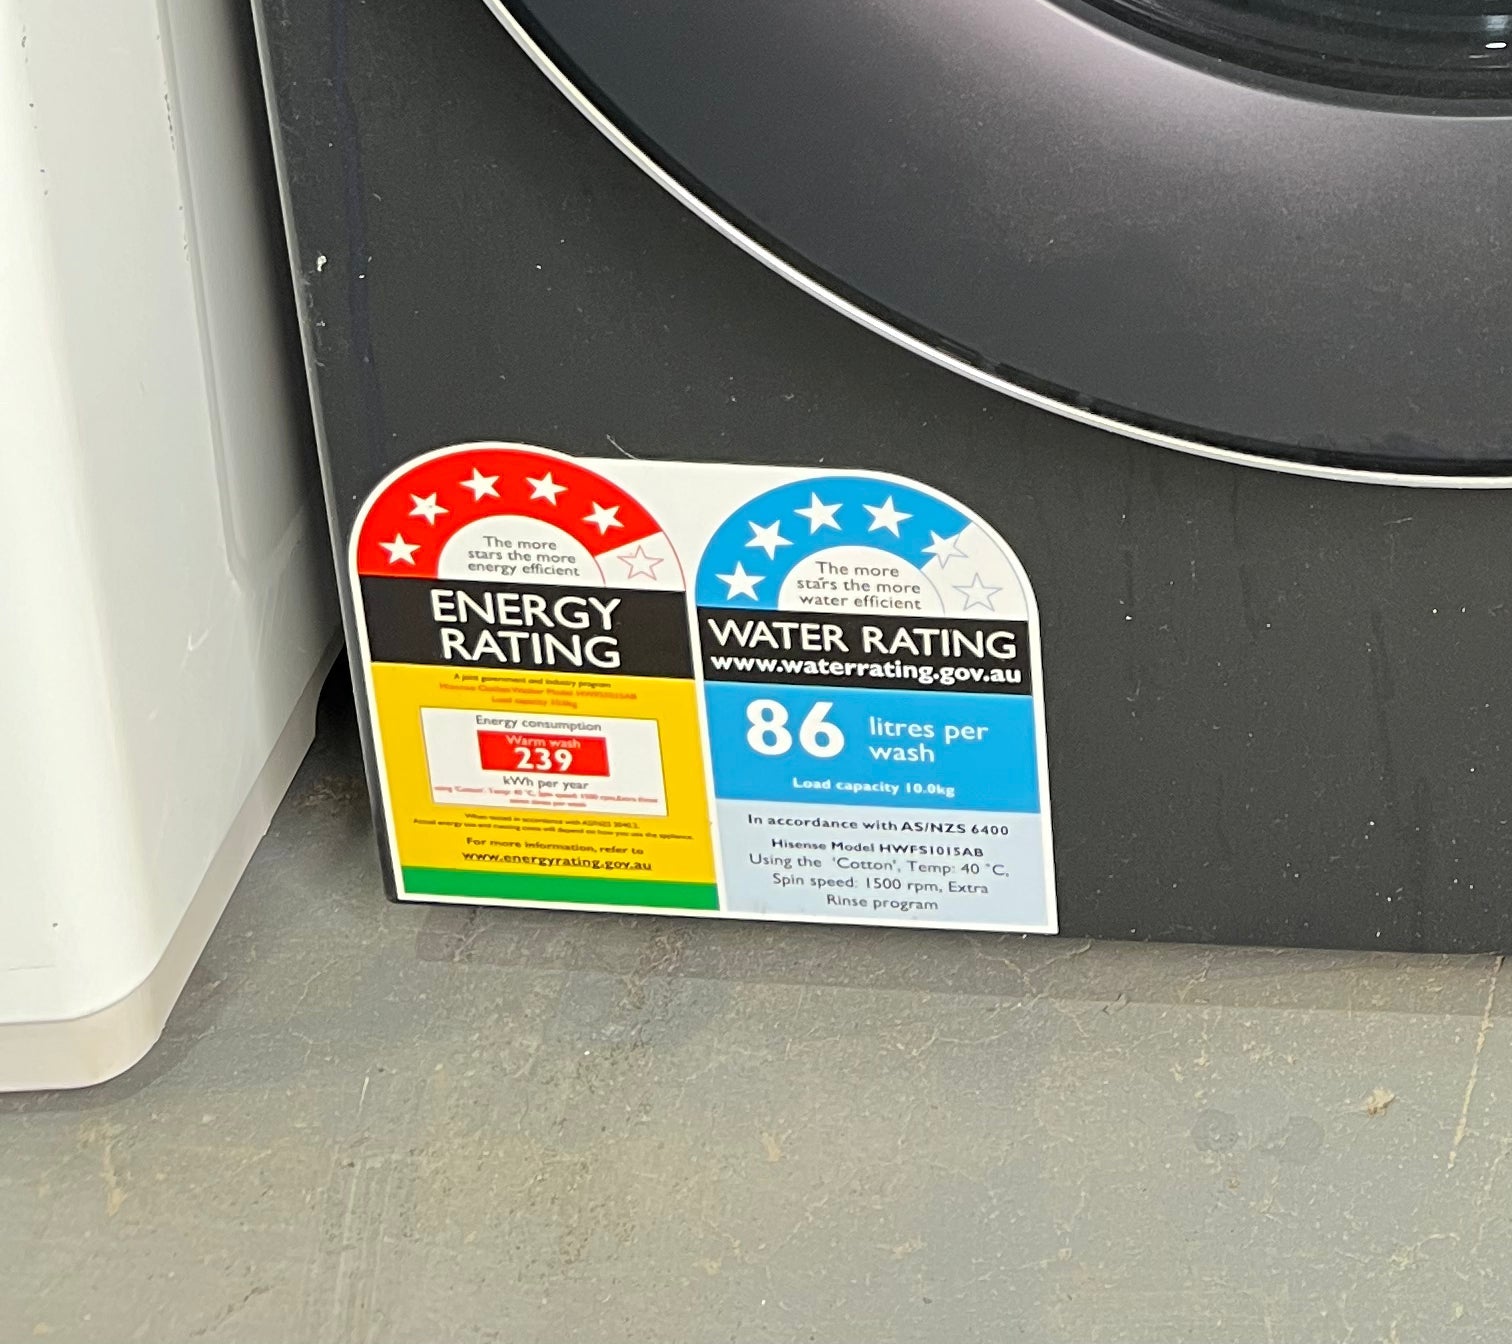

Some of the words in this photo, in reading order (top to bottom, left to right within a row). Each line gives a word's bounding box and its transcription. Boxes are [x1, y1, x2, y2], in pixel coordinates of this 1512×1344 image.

[483, 535, 513, 549] The
[517, 540, 557, 551] more
[468, 549, 504, 561] stars
[507, 550, 533, 562] the
[537, 553, 576, 564] more
[468, 563, 518, 576] energy
[522, 563, 580, 577] efficient
[815, 561, 849, 576] The
[854, 565, 900, 578] more
[797, 577, 838, 590] stars
[843, 579, 870, 592] the
[876, 582, 921, 594] more
[430, 589, 621, 631] ENERGY
[799, 595, 849, 607] water
[853, 594, 922, 610] efficient
[440, 628, 621, 669] RATING
[707, 618, 850, 653] WATER
[862, 626, 1018, 661] RATING
[710, 655, 1022, 686] www.waterrating.gov.au
[476, 715, 517, 729] Energy
[522, 719, 602, 732] consumption
[746, 699, 845, 759] 86
[869, 716, 935, 739] litres
[944, 723, 989, 745] per
[507, 734, 546, 747] Warm
[550, 738, 581, 749] wash
[514, 747, 573, 771] 239
[869, 743, 936, 763] wash
[503, 776, 534, 788] kWh
[538, 779, 558, 791] per
[561, 780, 589, 791] year
[792, 777, 831, 790] Load
[836, 780, 900, 795] capacity
[905, 782, 955, 798] 10.0kg
[748, 814, 763, 825] In
[767, 816, 858, 830] accordance
[863, 820, 897, 831] with
[901, 821, 967, 834] AS/NZS
[971, 824, 1009, 836] 6400
[466, 836, 488, 847] For
[490, 839, 522, 849] more
[599, 844, 628, 855] refer
[632, 847, 644, 855] to
[771, 838, 826, 851] Hisense
[831, 841, 875, 853] Model
[462, 850, 653, 871] www.energyrating.gov.au
[749, 853, 792, 870] Using
[797, 855, 822, 868] the
[907, 860, 955, 876] Temp:
[961, 863, 980, 875] 40
[772, 873, 804, 887] Spin
[810, 876, 858, 890] speed:
[866, 876, 901, 890] 1500
[948, 881, 989, 894] Extra
[826, 894, 867, 908] Rinse
[872, 898, 938, 912] program
